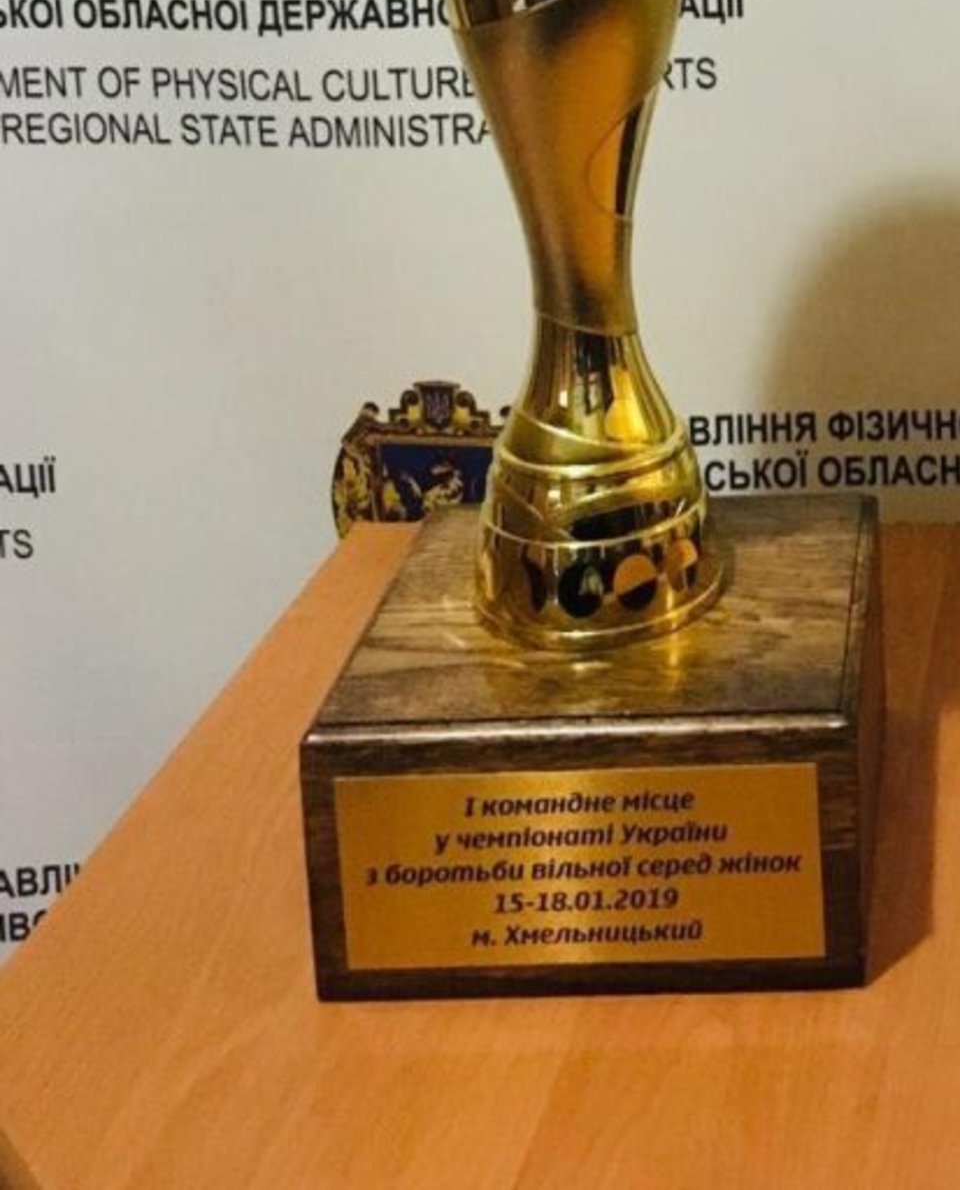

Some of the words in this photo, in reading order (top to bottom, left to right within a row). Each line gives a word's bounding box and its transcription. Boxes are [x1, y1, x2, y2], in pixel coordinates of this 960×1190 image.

[98, 65, 140, 99] OF
[152, 65, 312, 103] PHYSICAL
[1, 112, 172, 146] REGIONAL
[180, 112, 279, 148] STATE
[481, 793, 616, 815] командне
[622, 790, 695, 813] місце
[434, 833, 450, 855] у
[456, 825, 614, 848] чемпіонаті
[620, 821, 728, 847] України
[385, 862, 524, 885] боротьби
[531, 857, 631, 880] вільної
[637, 855, 712, 879] серед
[718, 854, 802, 873] жінок
[494, 888, 679, 914] 15-18.01.2019
[471, 931, 497, 947] м.
[504, 920, 704, 946] Хмельницький
